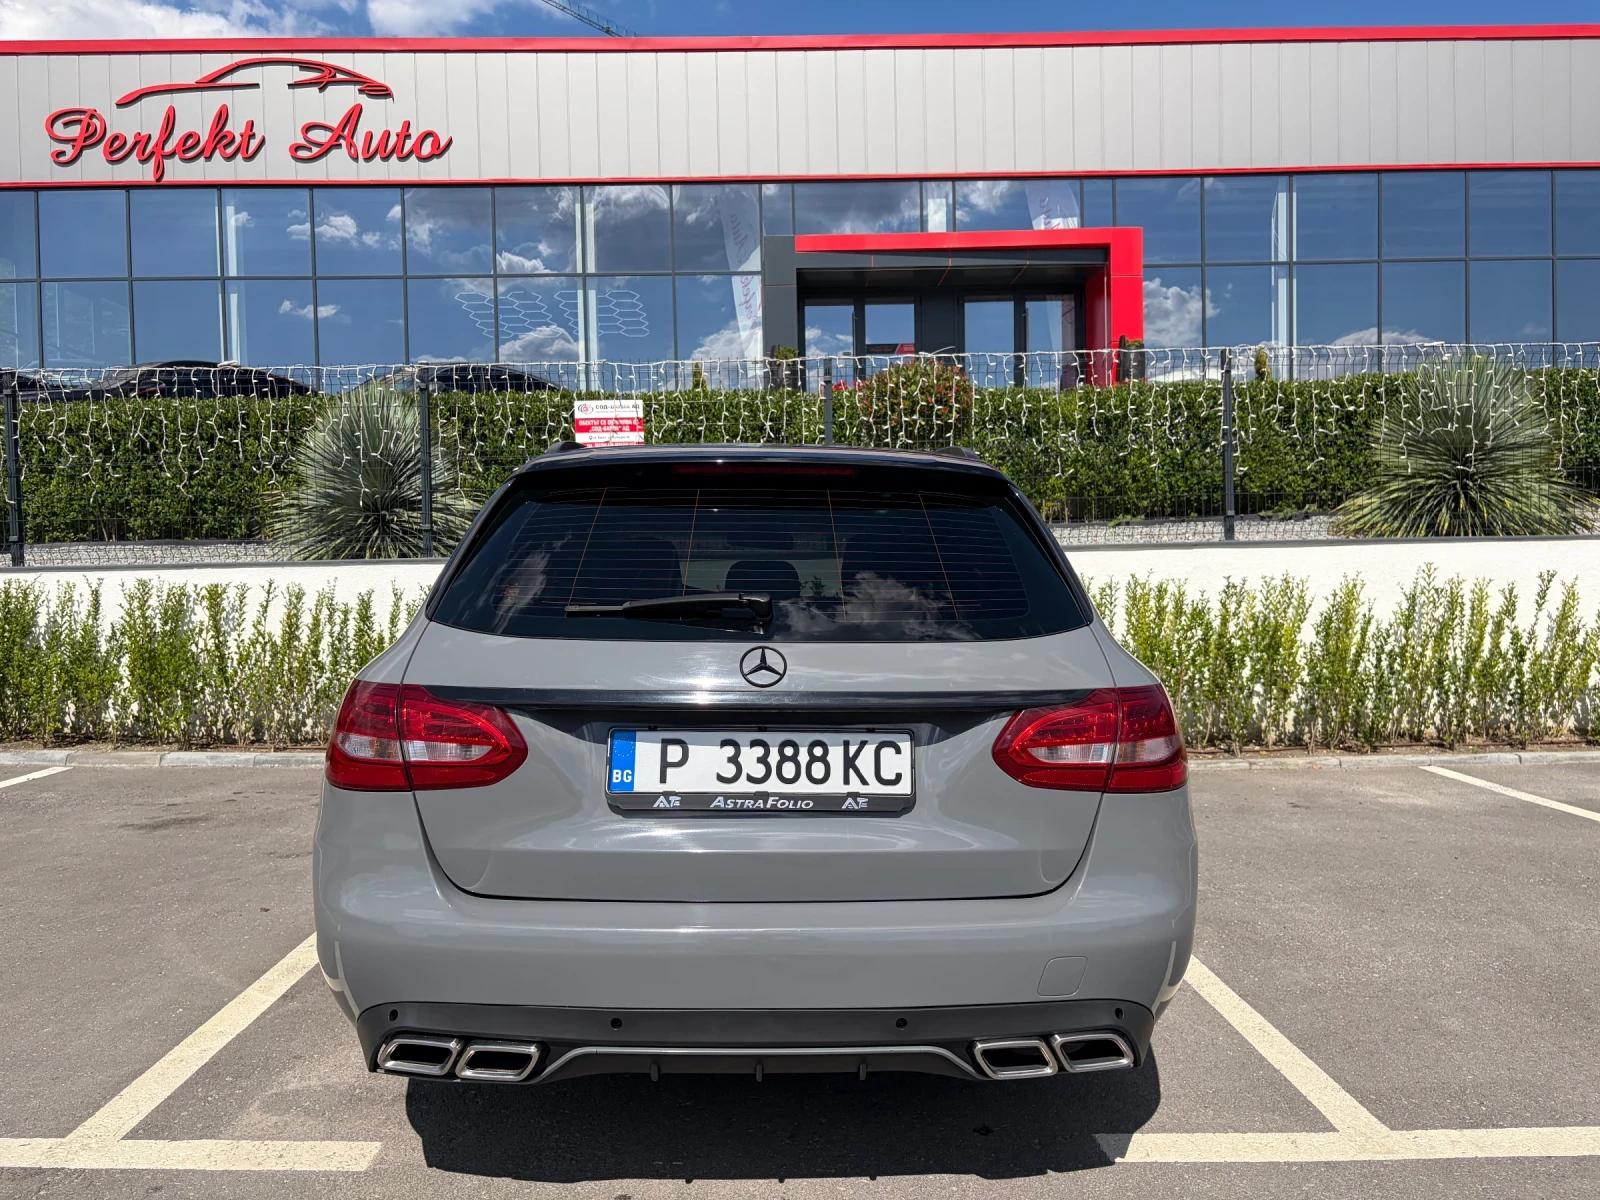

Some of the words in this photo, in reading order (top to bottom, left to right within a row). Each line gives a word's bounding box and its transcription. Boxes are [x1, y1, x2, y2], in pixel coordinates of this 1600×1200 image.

[45, 103, 265, 182] Perfekt
[288, 103, 453, 161] Auto
[612, 769, 633, 783] BG
[659, 738, 690, 784] P
[716, 738, 831, 785] 3388
